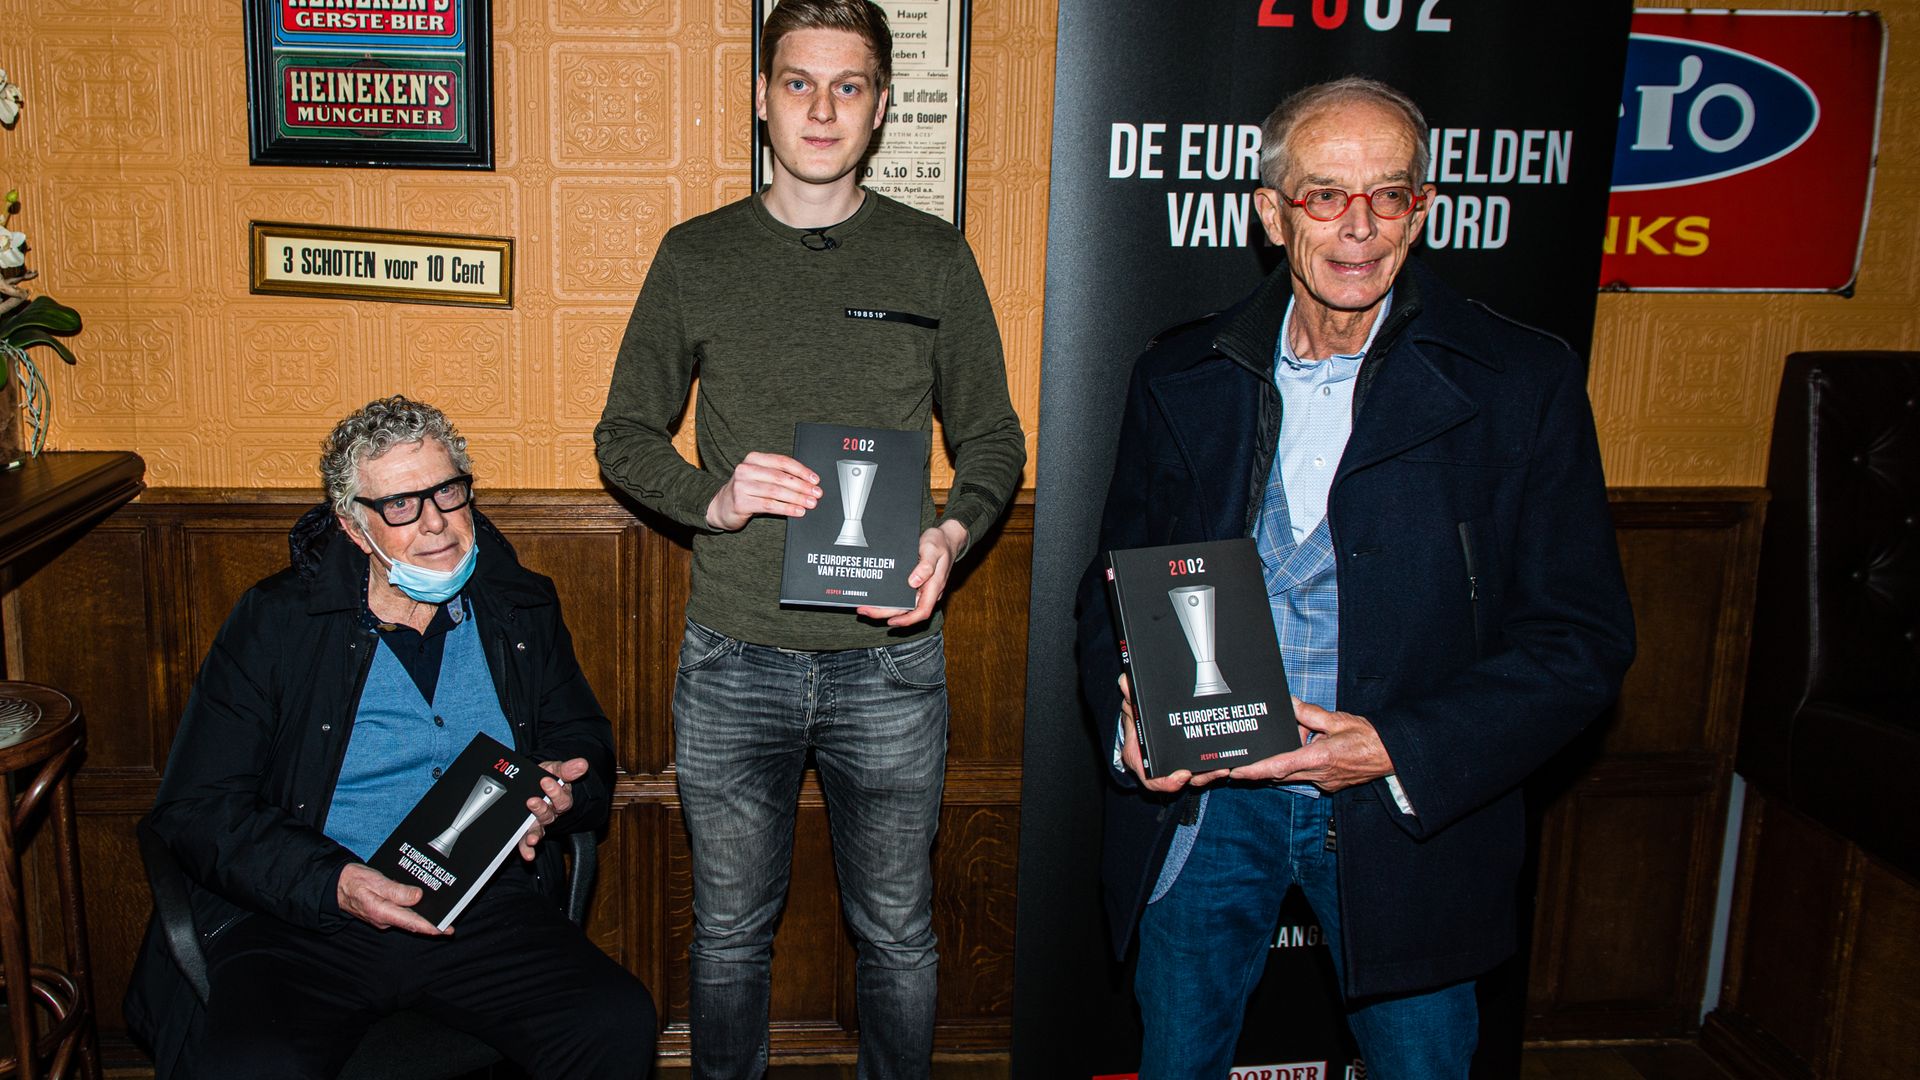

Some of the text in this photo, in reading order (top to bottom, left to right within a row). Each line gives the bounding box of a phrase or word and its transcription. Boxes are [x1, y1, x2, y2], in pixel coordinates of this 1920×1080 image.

[897, 10, 928, 21] Haupt
[891, 30, 927, 39] iezorek
[892, 50, 918, 59] ieben
[290, 71, 450, 107] HEINEKEN'S
[297, 104, 443, 126] MÜNCHENER
[885, 112, 899, 124] ijk
[902, 112, 914, 123] de
[1109, 122, 1167, 180] DE
[883, 166, 908, 178] 4.10
[916, 166, 941, 178] 5.10
[904, 186, 922, 194] April
[1167, 192, 1249, 248] VAN
[283, 246, 485, 285] 3 SCHOTEN voor 10 Cent
[843, 438, 875, 452] 2002
[807, 553, 895, 570] DE EUROPESE HELDEN
[1168, 557, 1206, 576] 2002
[817, 565, 884, 580] VAN FEYENOORD
[1119, 640, 1130, 664] 2002
[1168, 702, 1268, 726] DE EUROPESE HELDEN
[1183, 718, 1259, 739] VAN FEYENOORD
[494, 758, 520, 779] 2002
[398, 855, 443, 891] VAN FEYENOORD
[399, 842, 457, 887] DE EUROPESE HELDEN
